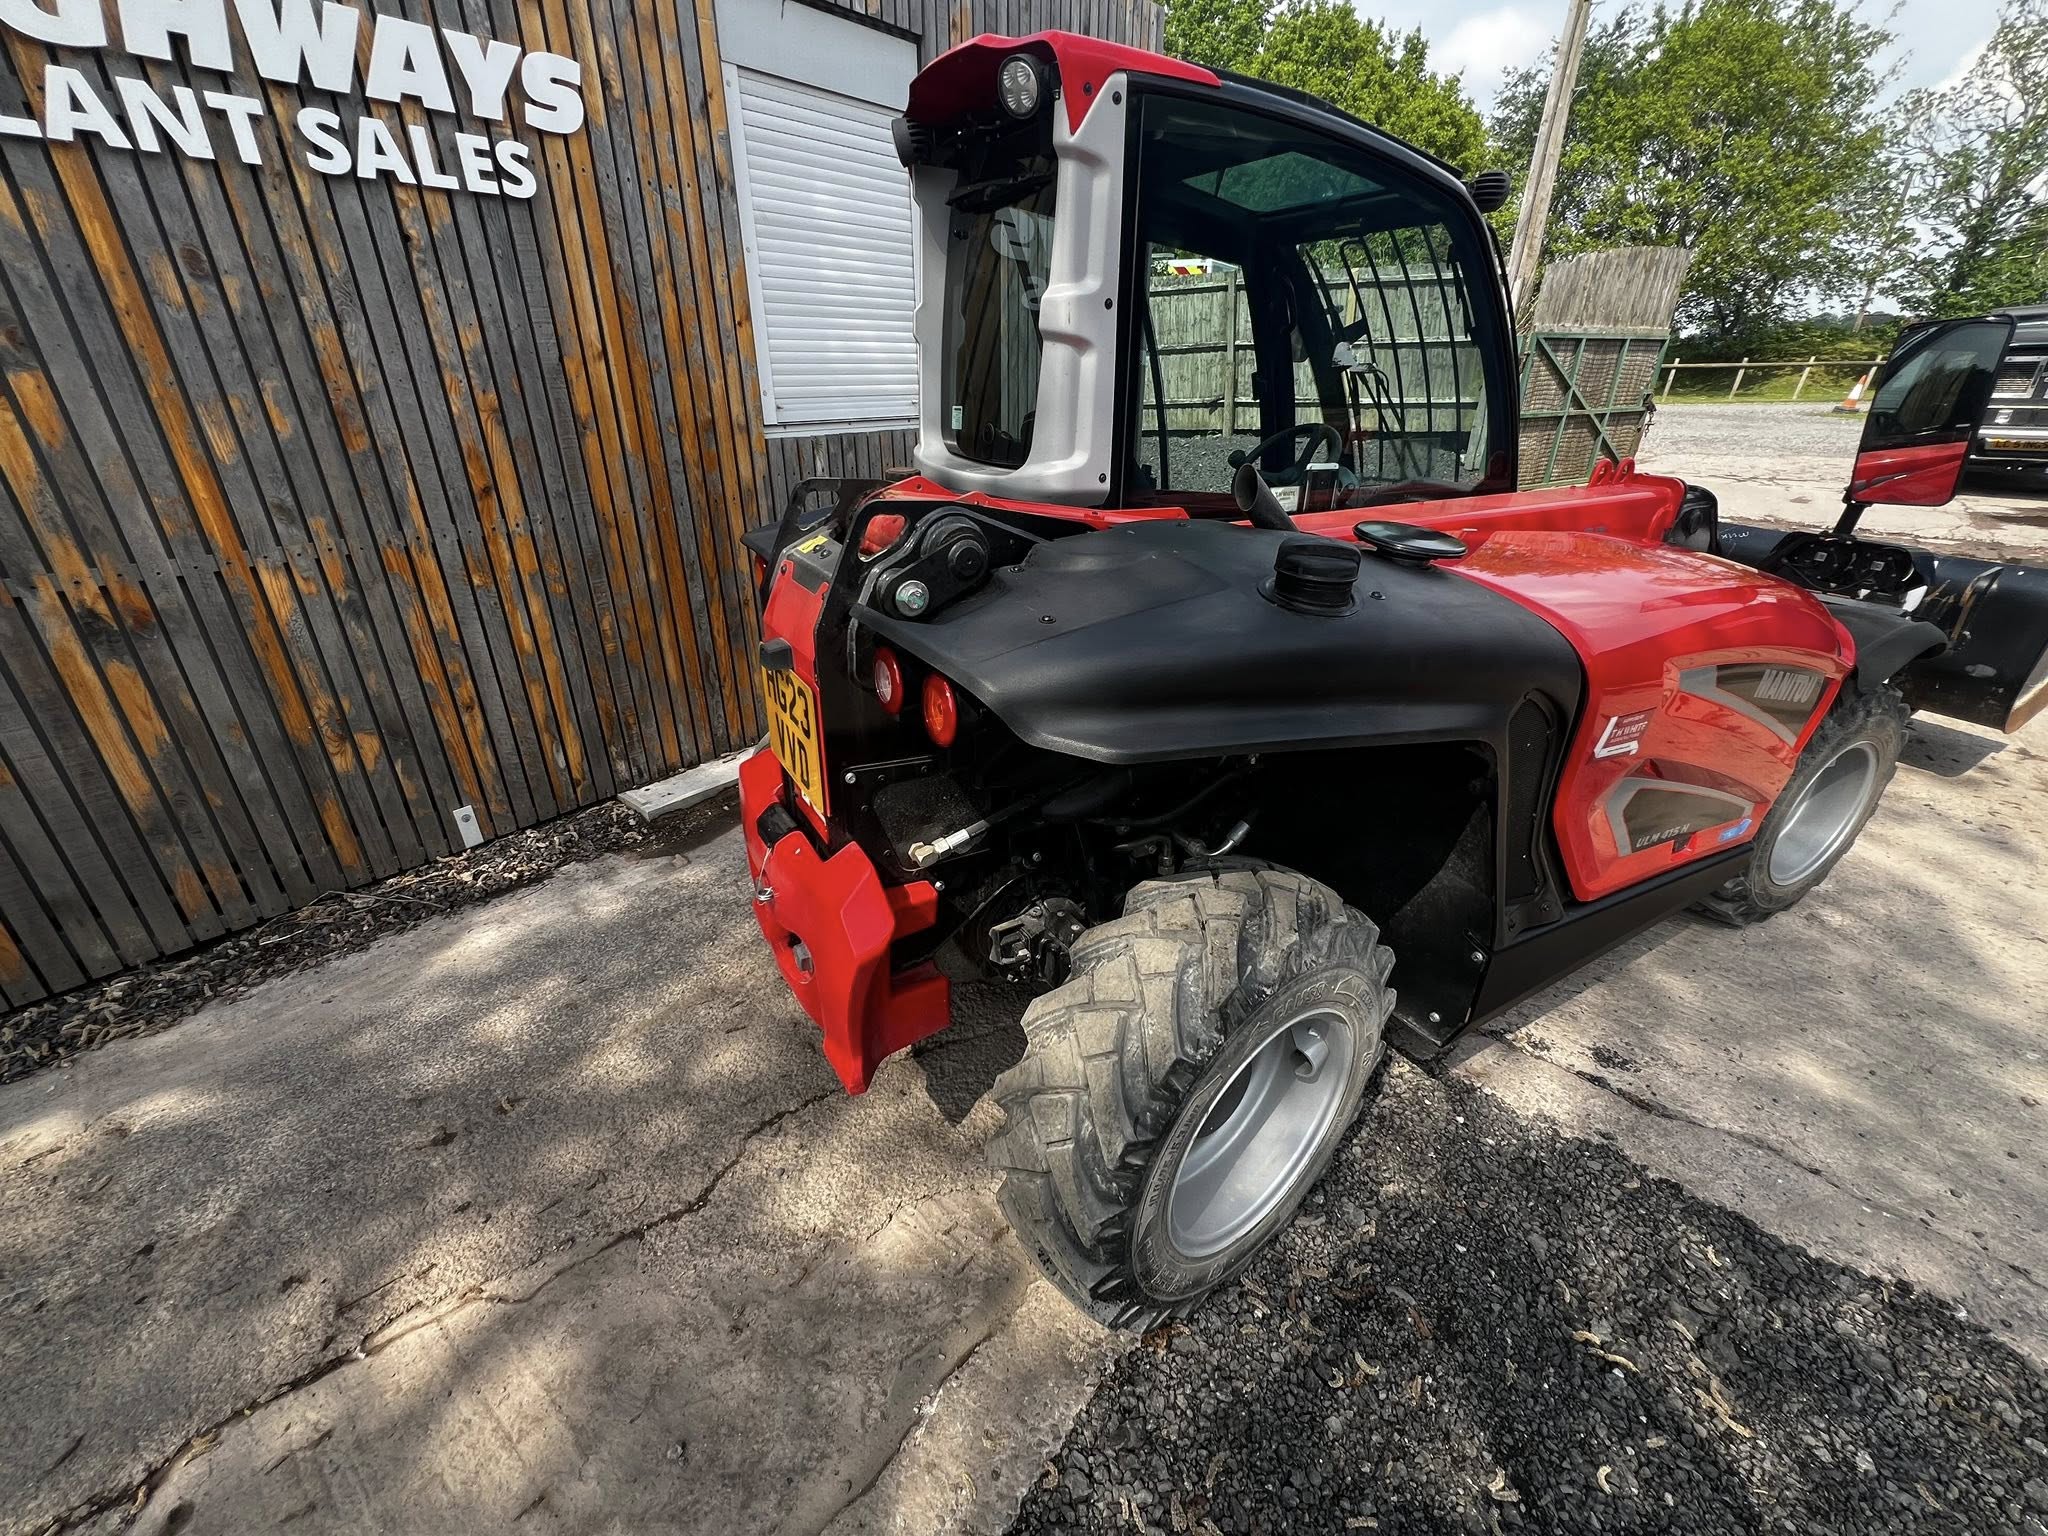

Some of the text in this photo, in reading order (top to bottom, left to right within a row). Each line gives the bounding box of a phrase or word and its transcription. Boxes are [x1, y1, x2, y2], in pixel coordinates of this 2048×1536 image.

[296, 107, 537, 199] SALES
[1754, 669, 1817, 703] MANITOU
[775, 712, 811, 790] VVD
